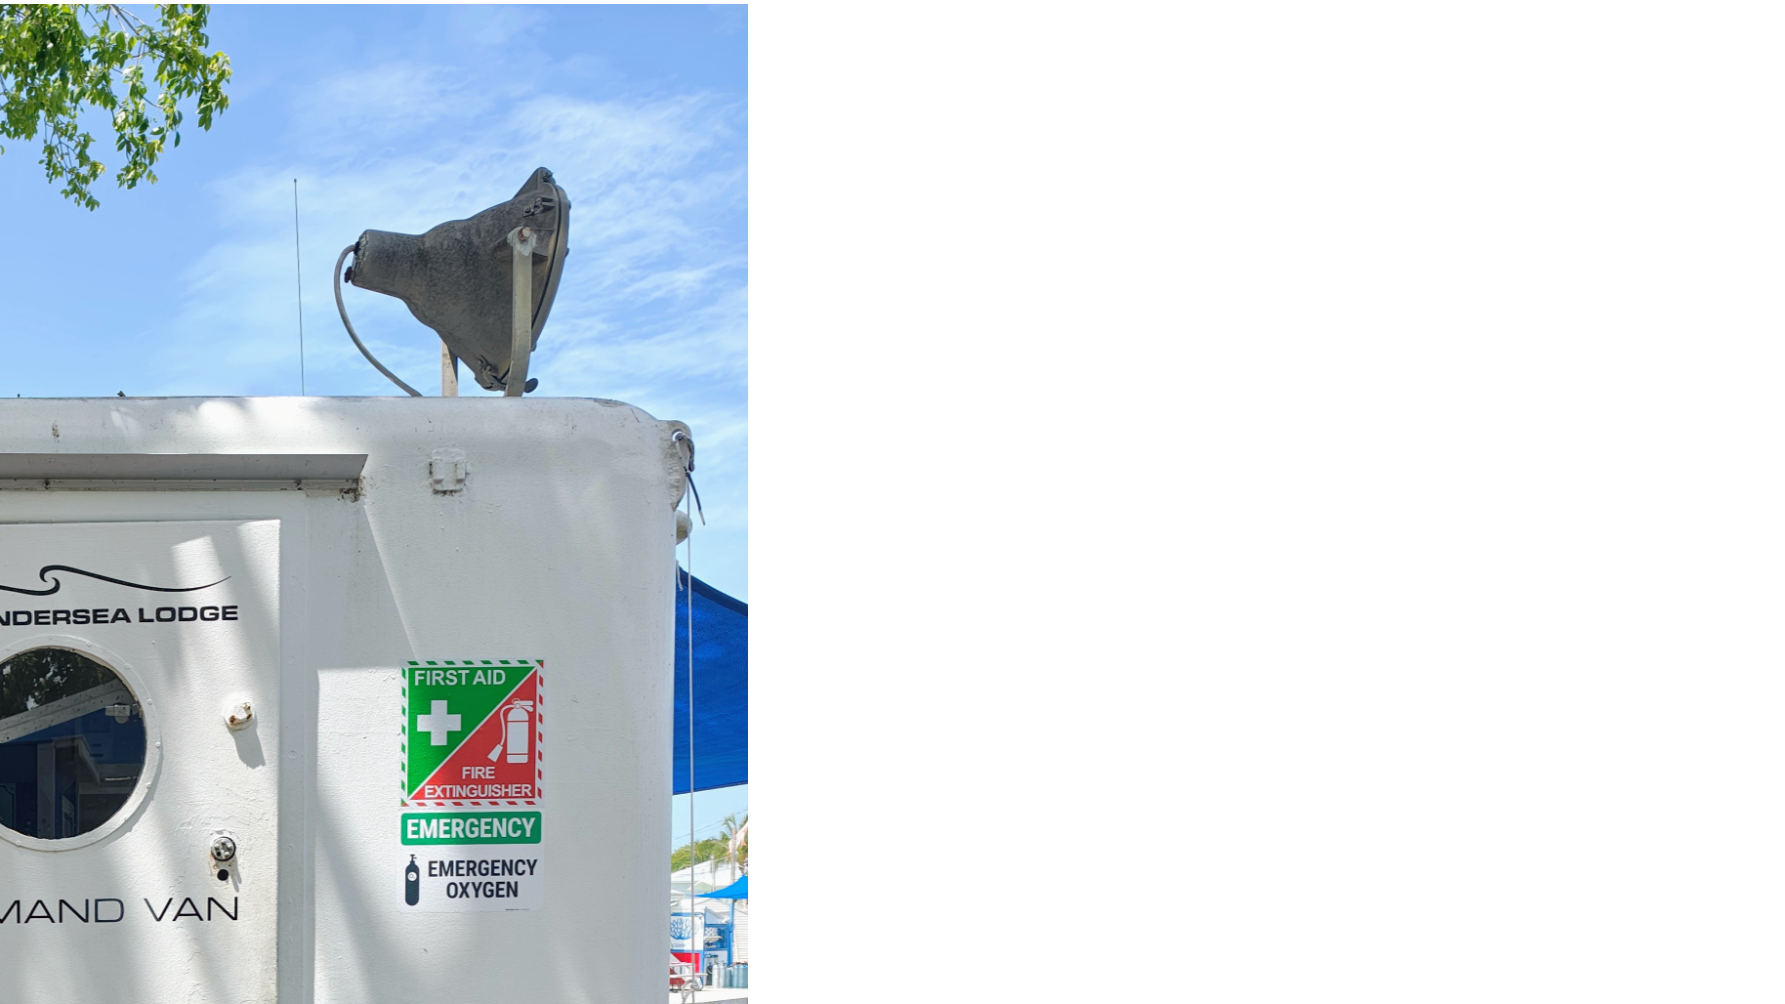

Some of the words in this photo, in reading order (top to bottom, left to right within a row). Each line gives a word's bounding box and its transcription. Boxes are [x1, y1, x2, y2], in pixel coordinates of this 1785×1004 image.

[138, 605, 239, 623] LODGE
[414, 669, 470, 686] FIRST
[472, 669, 506, 685] AID
[462, 766, 495, 779] FIRE
[424, 783, 532, 799] EXTINGUISHER
[406, 817, 536, 840] EMERGENCY
[427, 858, 538, 878] EMERGENCY
[446, 881, 519, 899] OXYGEN
[143, 896, 238, 922] VAN
